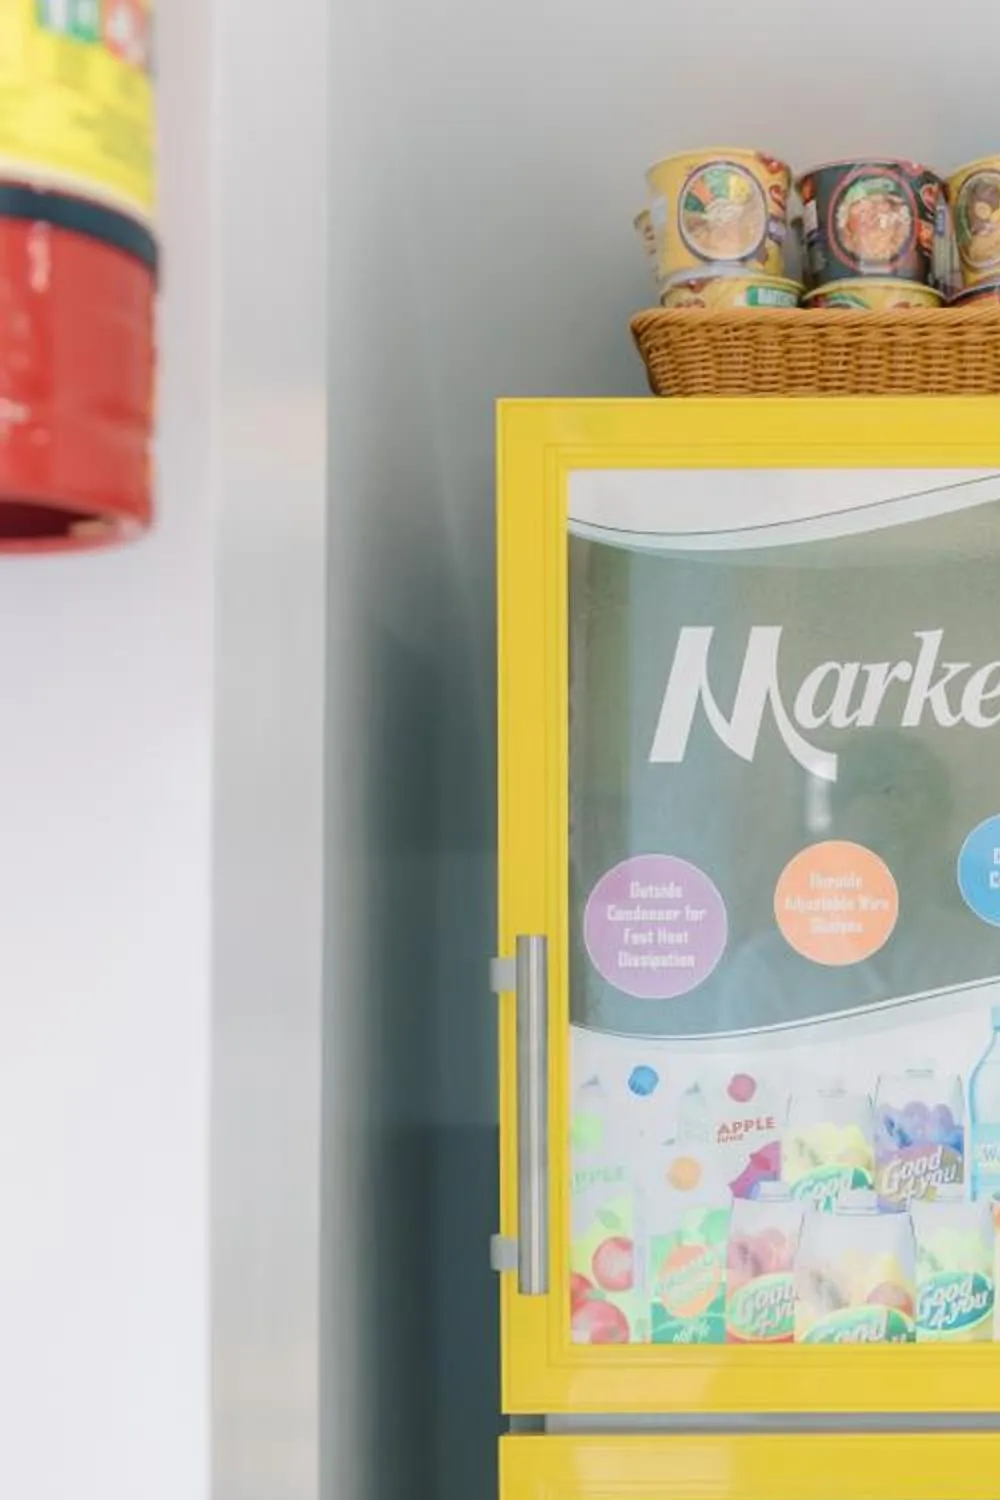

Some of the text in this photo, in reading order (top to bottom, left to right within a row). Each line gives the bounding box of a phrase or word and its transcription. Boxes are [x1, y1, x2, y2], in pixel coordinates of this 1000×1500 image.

[607, 904, 681, 921] Condenser
[624, 928, 689, 945] Fast Heat
[716, 1115, 777, 1135] APPLE
